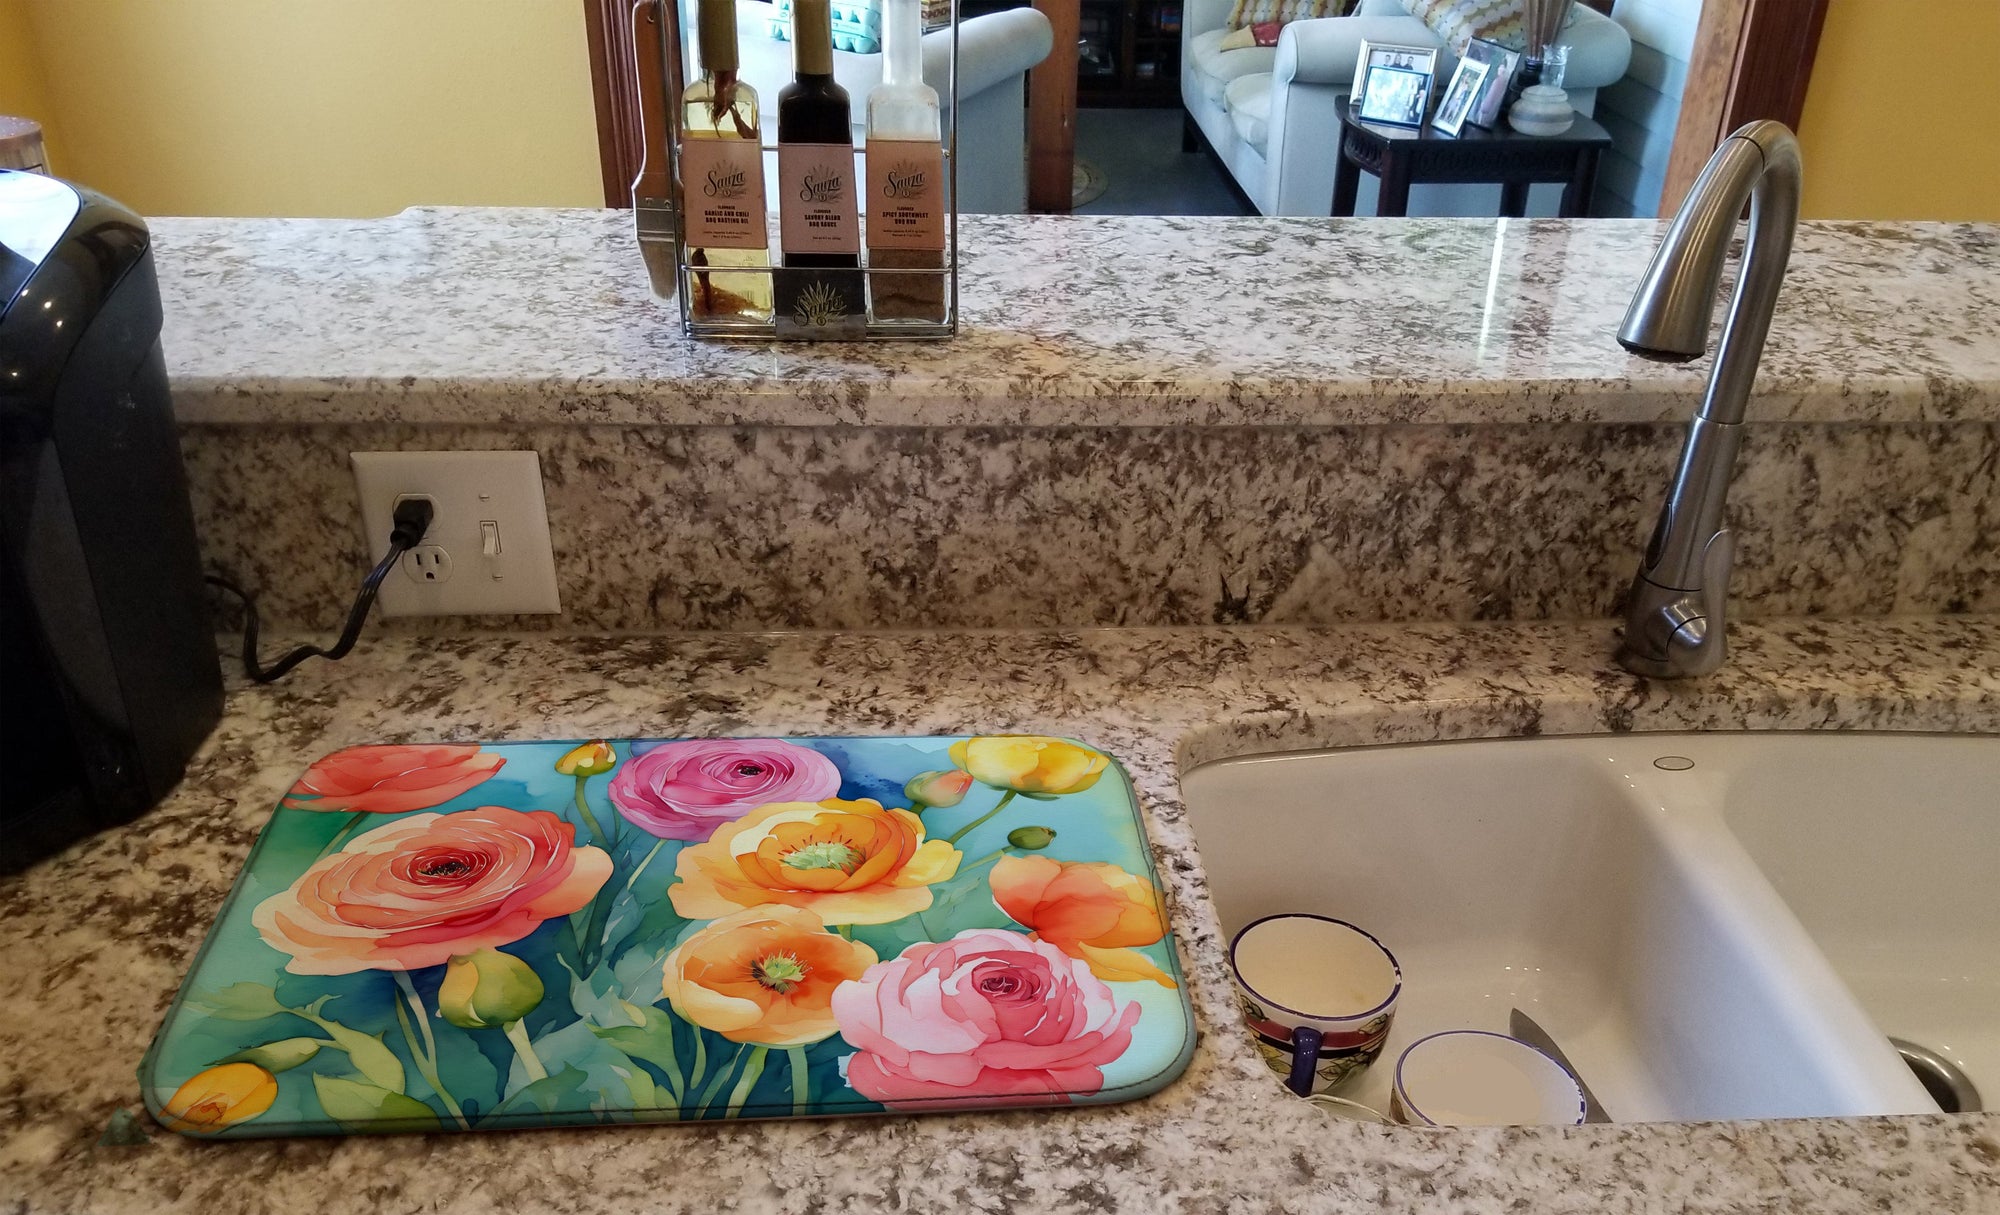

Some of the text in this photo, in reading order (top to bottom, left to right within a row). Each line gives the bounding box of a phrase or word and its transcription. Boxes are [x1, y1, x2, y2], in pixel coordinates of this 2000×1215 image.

[704, 170, 745, 197] Sauza
[800, 175, 841, 202] Sauza
[883, 171, 924, 198] Sauza
